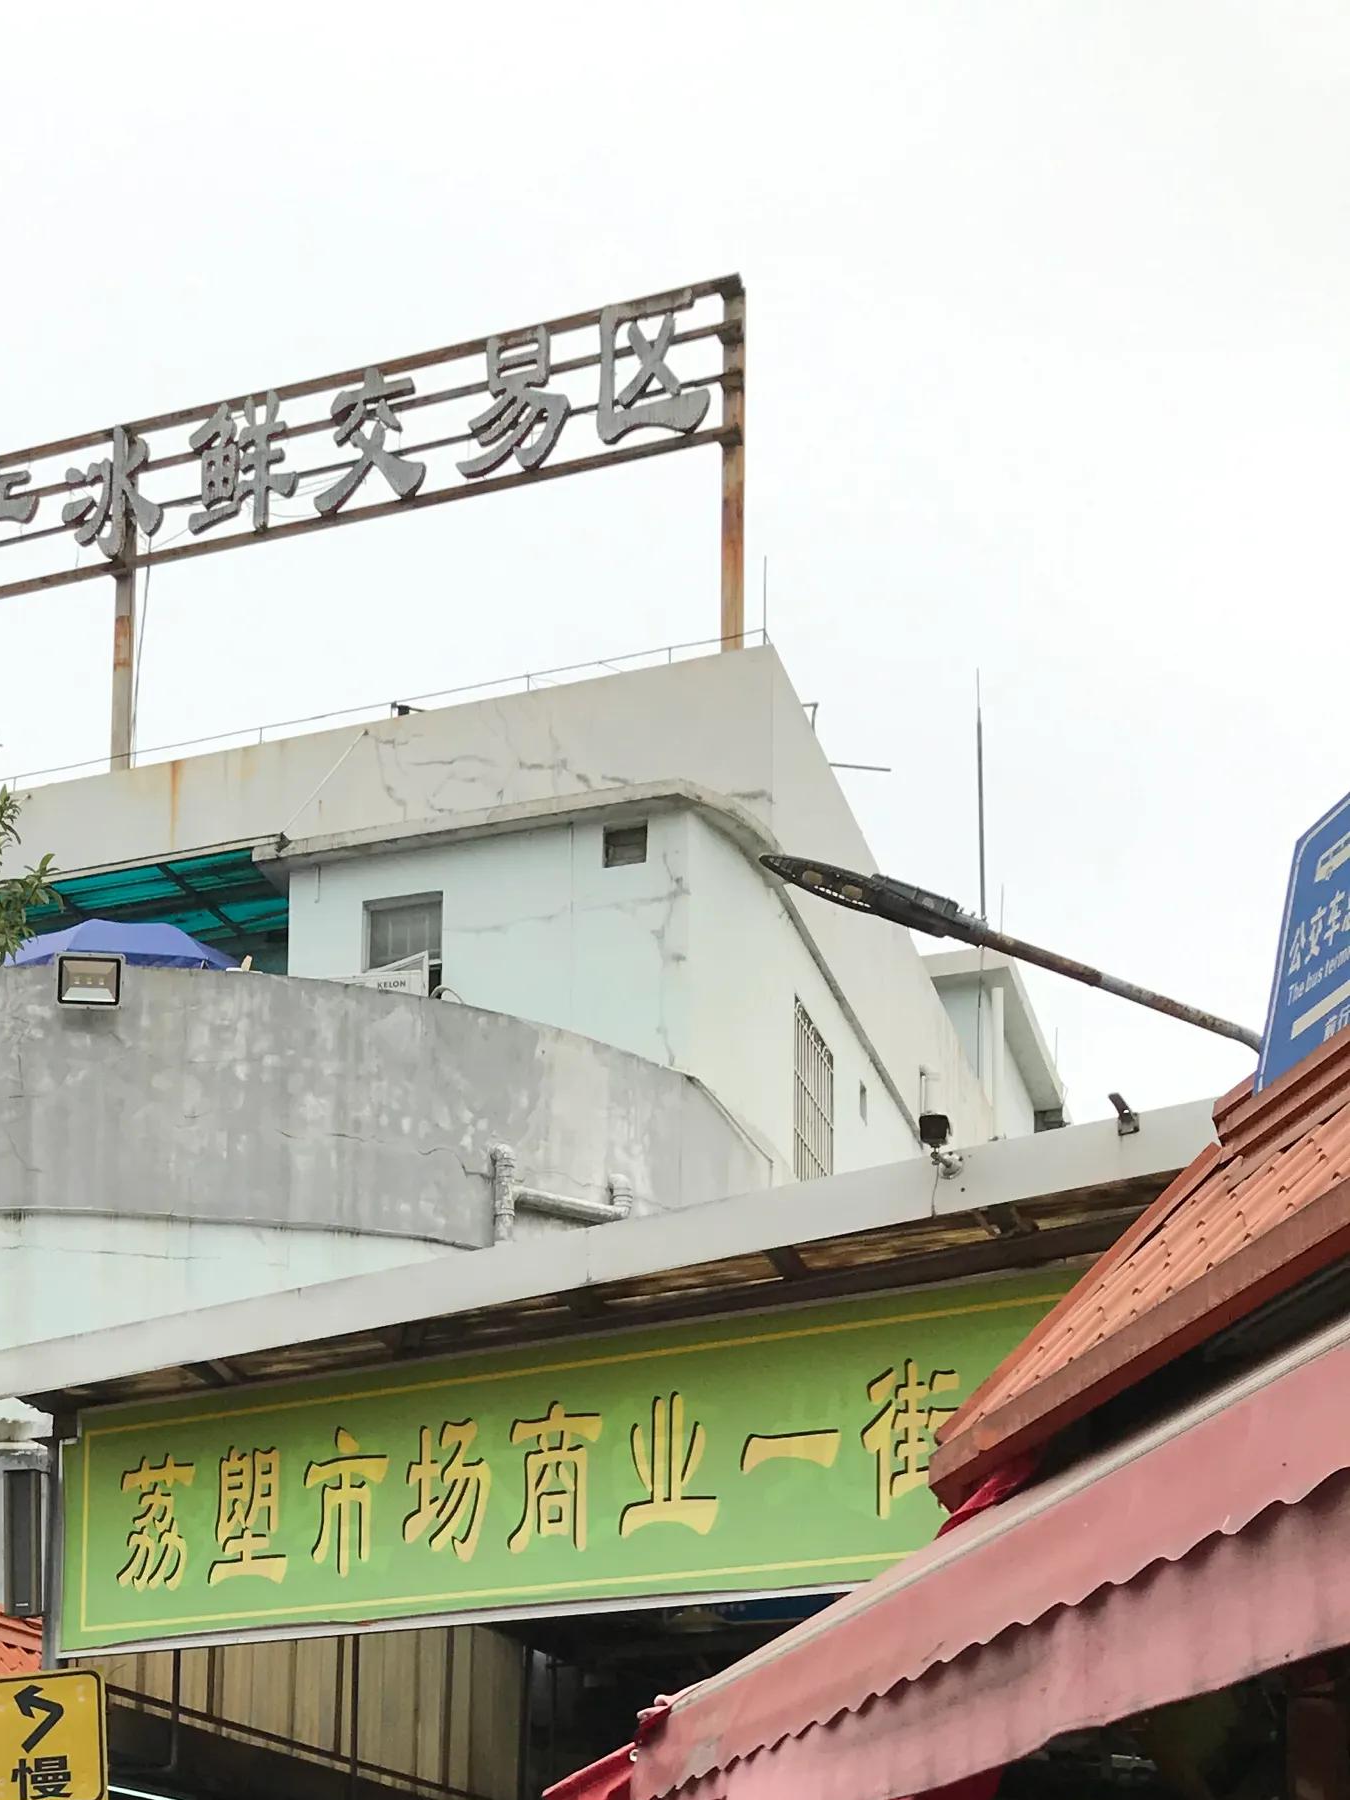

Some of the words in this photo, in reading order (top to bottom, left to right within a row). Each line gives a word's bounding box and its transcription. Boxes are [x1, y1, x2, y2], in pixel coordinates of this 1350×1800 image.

[377, 980, 407, 989] KELON
[1287, 981, 1304, 1006] The
[1305, 967, 1324, 993] bus
[117, 1358, 960, 1590] 荔塱市场商业一街
[11, 1754, 73, 1800] 慢
